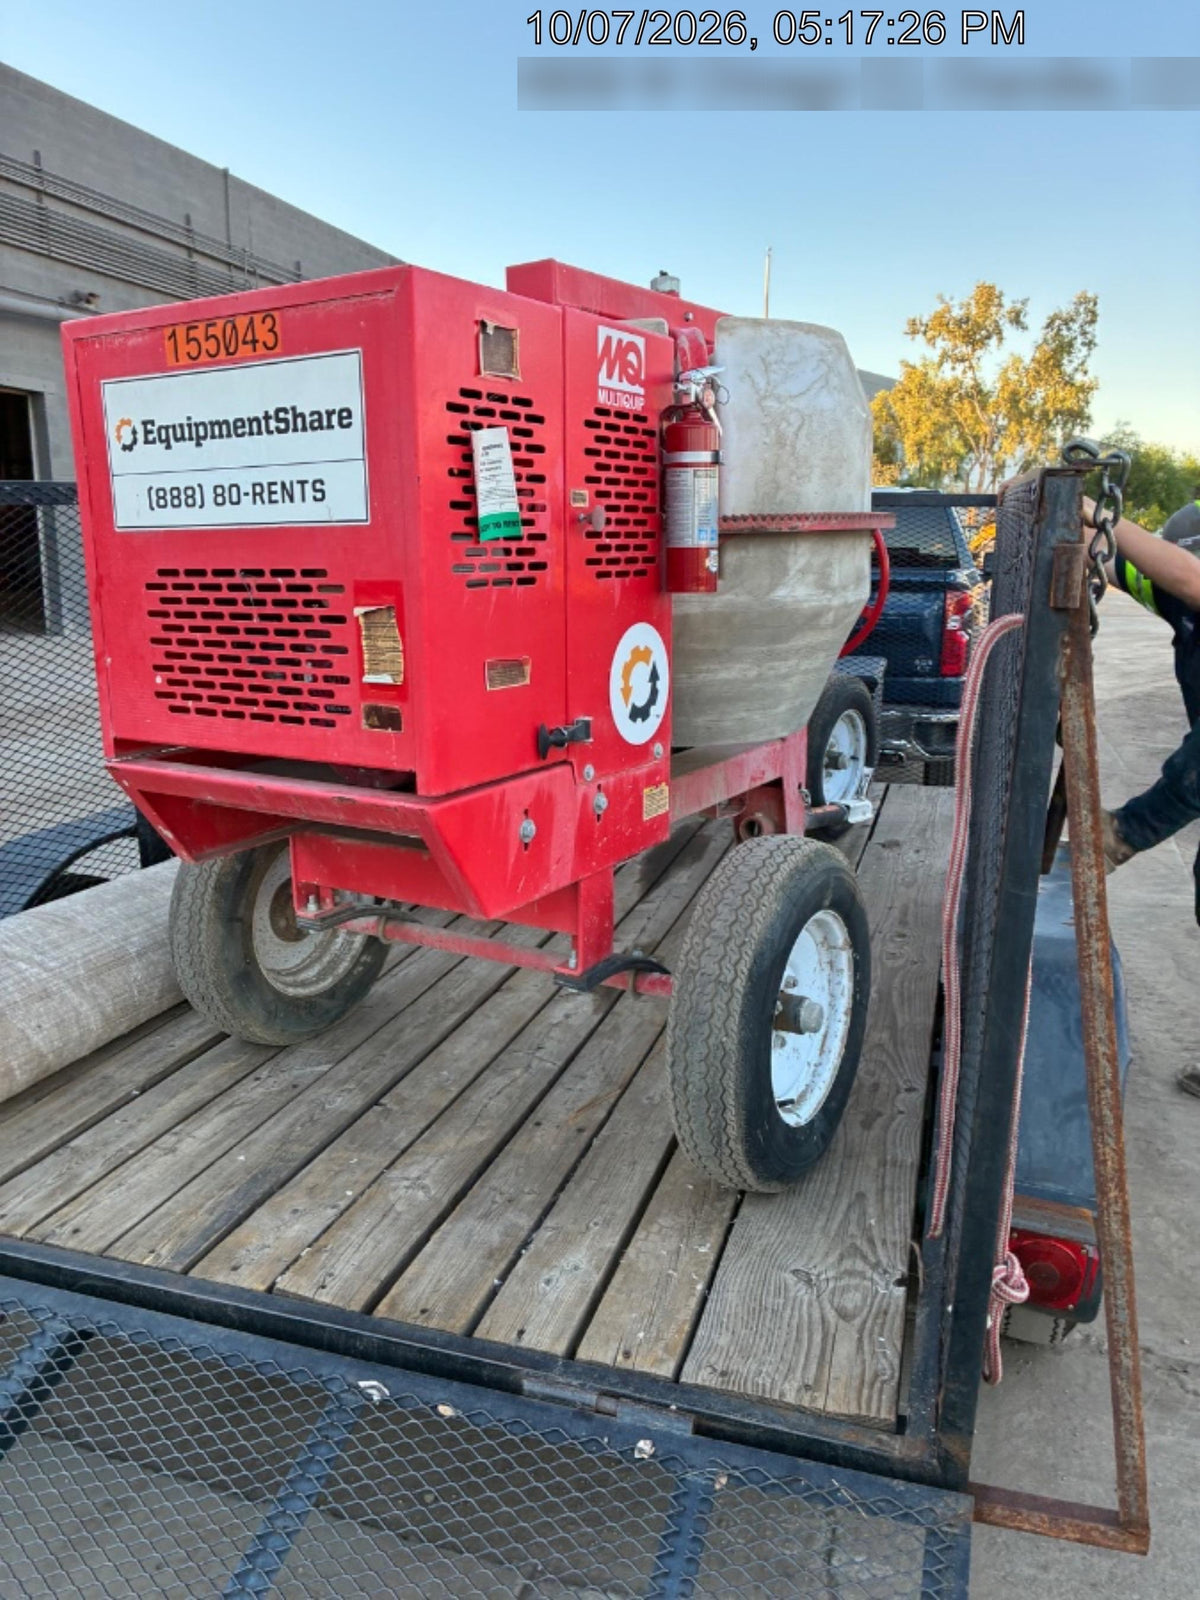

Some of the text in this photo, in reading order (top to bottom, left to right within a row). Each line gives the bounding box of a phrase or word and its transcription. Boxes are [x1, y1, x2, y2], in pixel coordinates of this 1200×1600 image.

[167, 313, 279, 363] 155043
[598, 388, 645, 411] MULTIQUIP
[141, 405, 353, 450] EquipmentShare
[147, 479, 327, 510] (888) 80-RENTS
